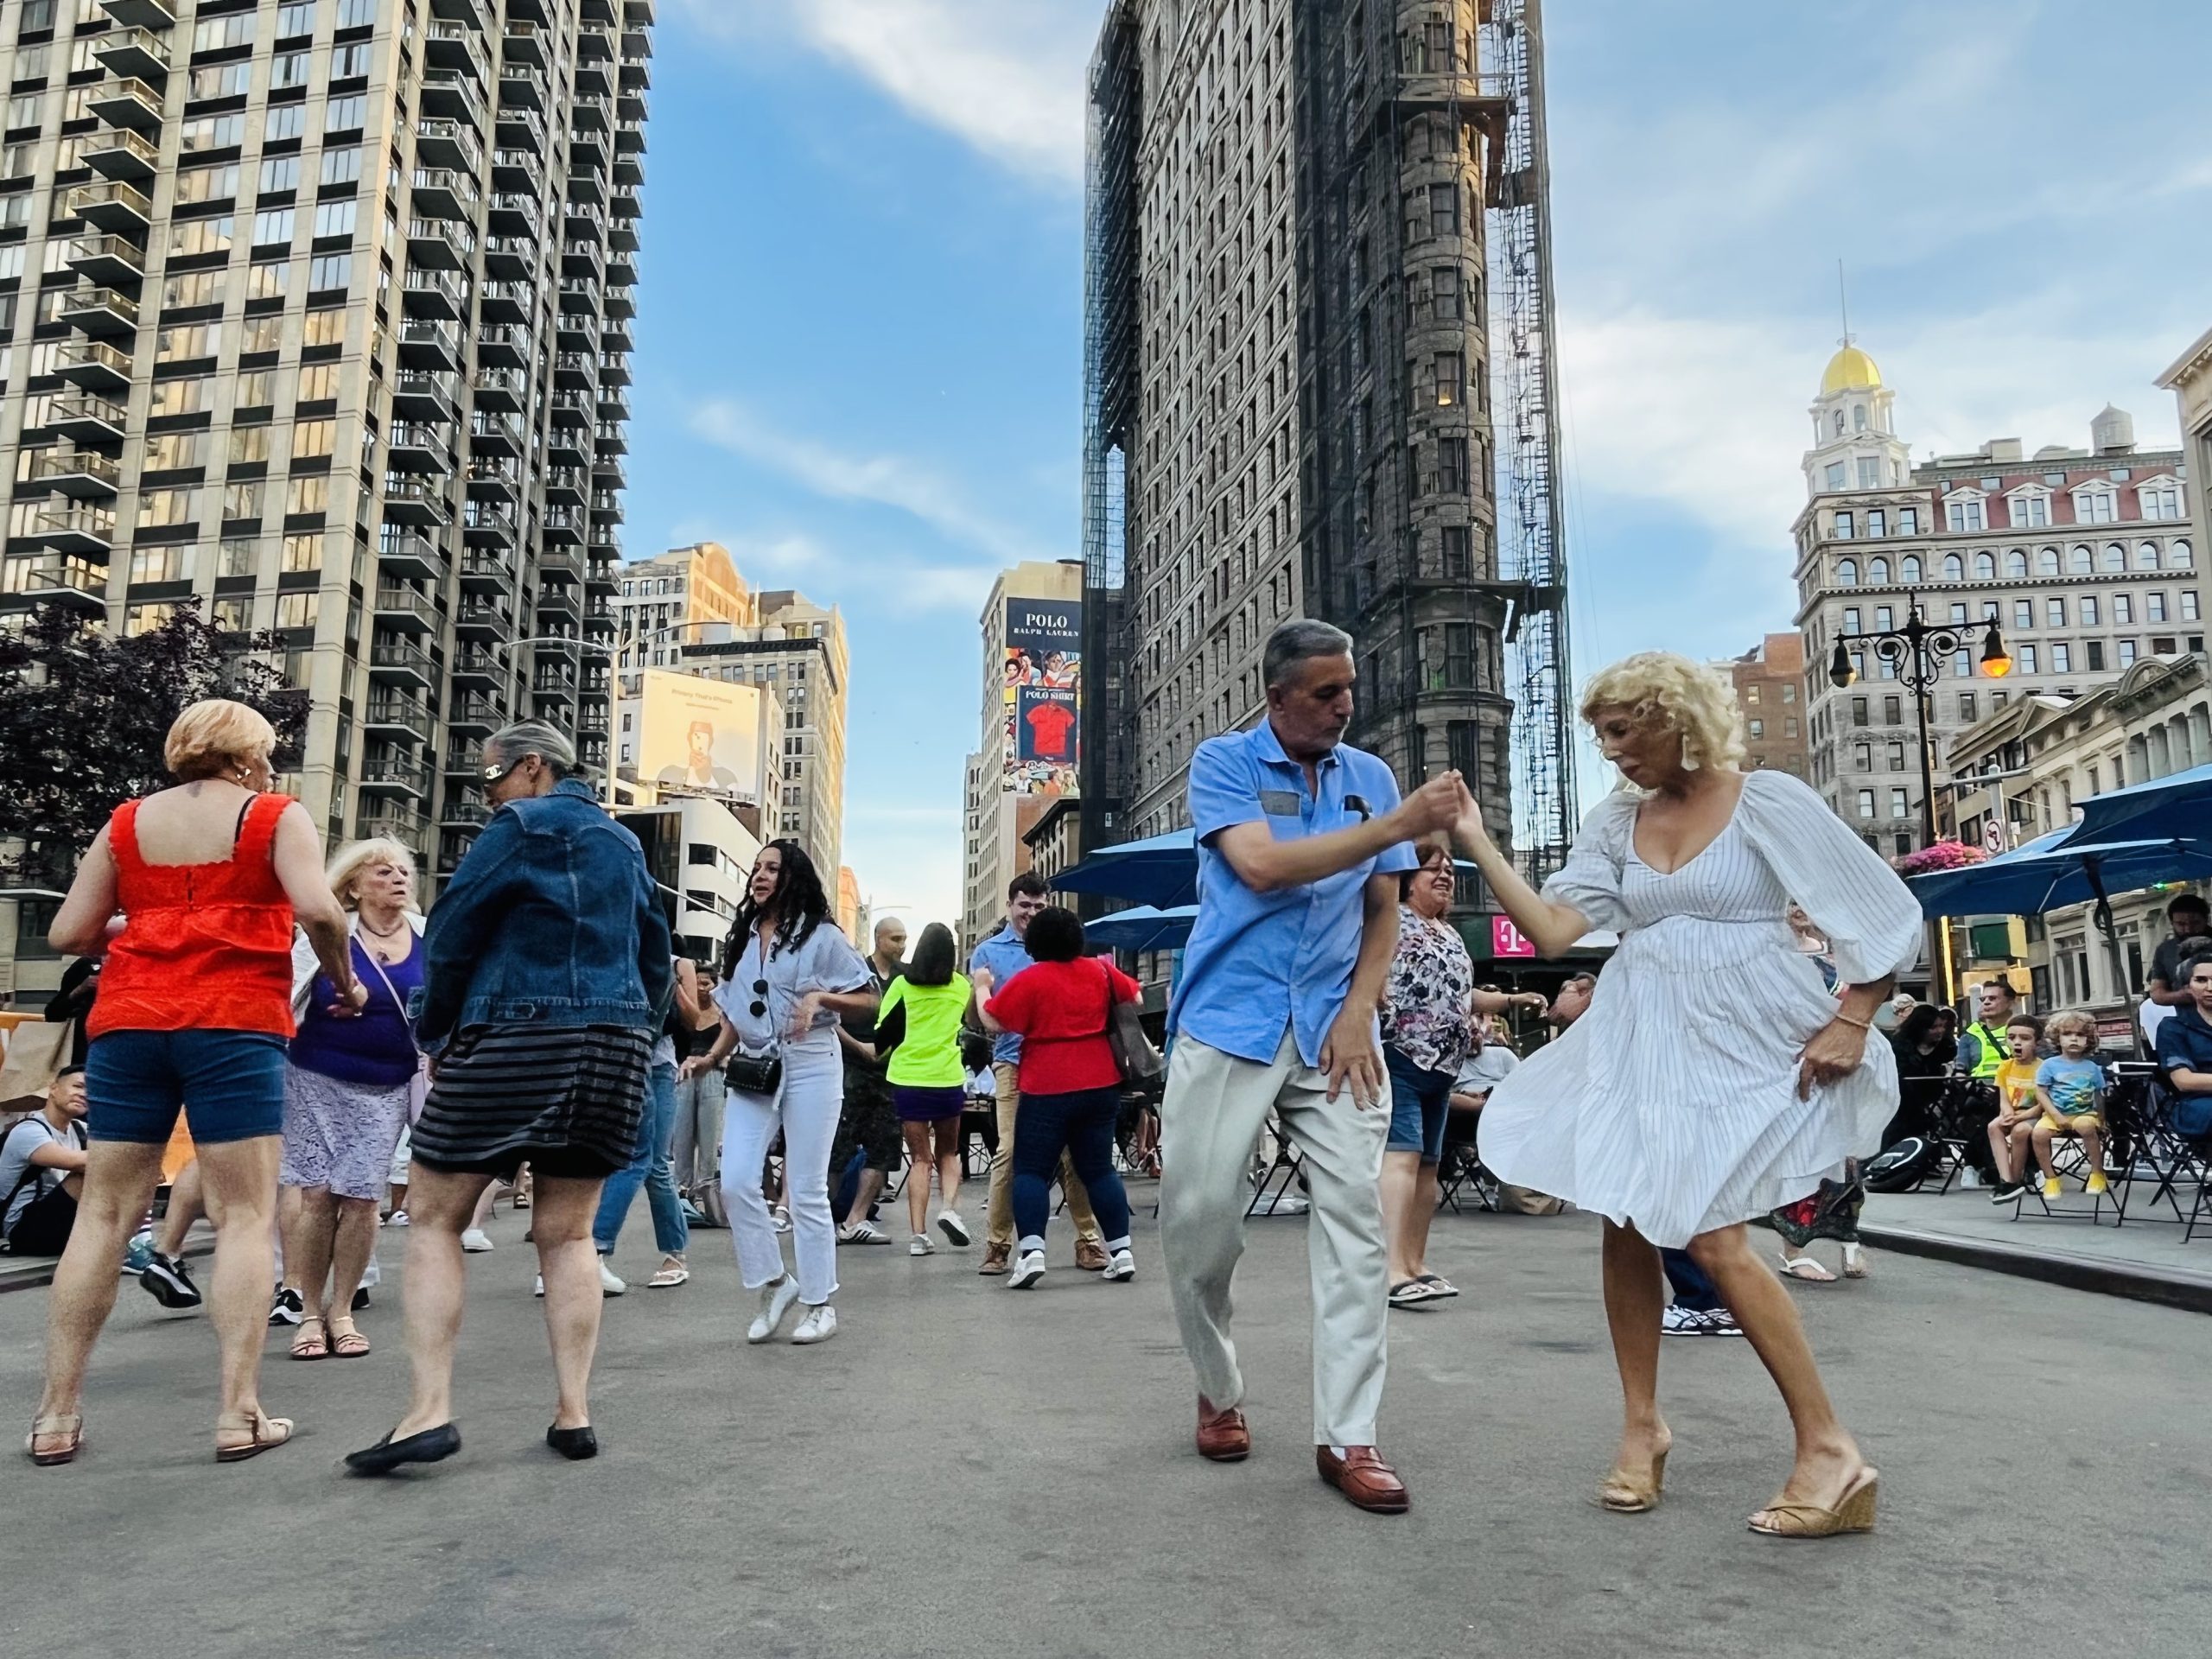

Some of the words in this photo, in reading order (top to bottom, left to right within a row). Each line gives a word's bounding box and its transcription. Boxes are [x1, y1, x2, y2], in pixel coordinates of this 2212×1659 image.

[1027, 613, 1068, 628] POLO
[1026, 690, 1050, 699] POLO
[1050, 691, 1075, 701] SHIRT
